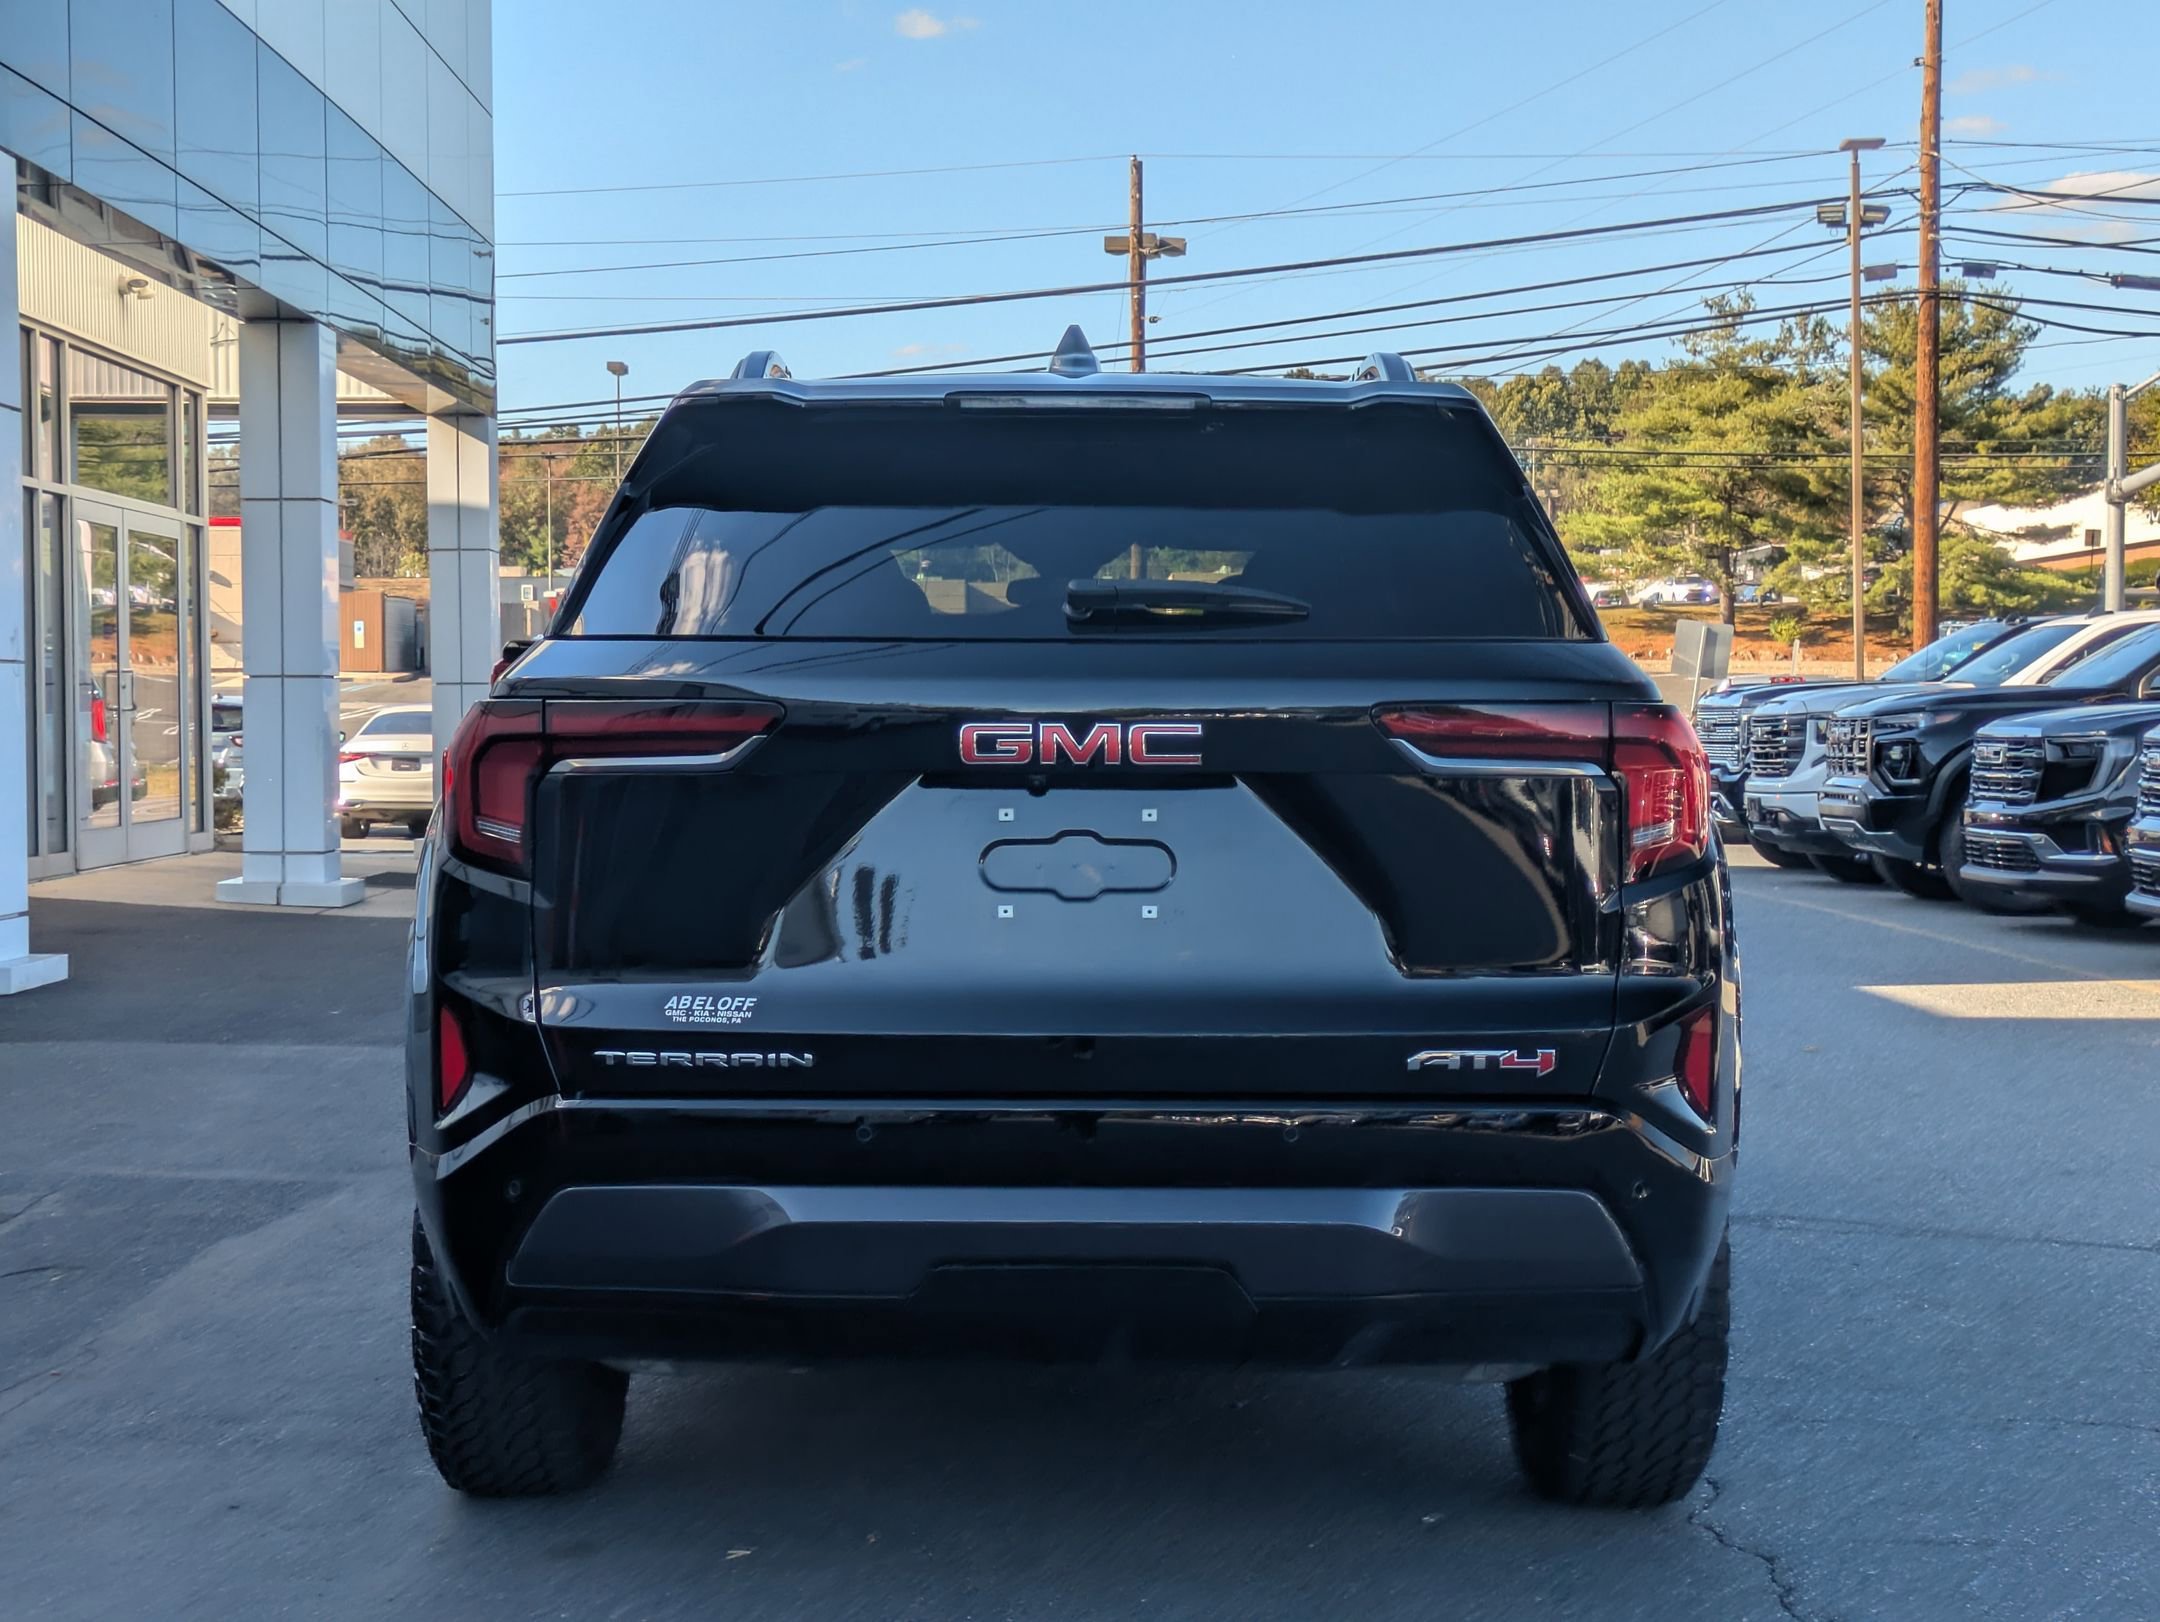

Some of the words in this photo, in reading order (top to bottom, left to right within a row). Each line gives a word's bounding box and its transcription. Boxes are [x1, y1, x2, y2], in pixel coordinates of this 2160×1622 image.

[959, 722, 1202, 765] GMC
[663, 995, 758, 1011] ABELOFF
[665, 1009, 687, 1017] GMC
[717, 1010, 752, 1018] NISSAN
[688, 1016, 730, 1025] POCONOS,
[593, 1050, 814, 1068] TERRAIN
[1407, 1049, 1556, 1077] AT4
